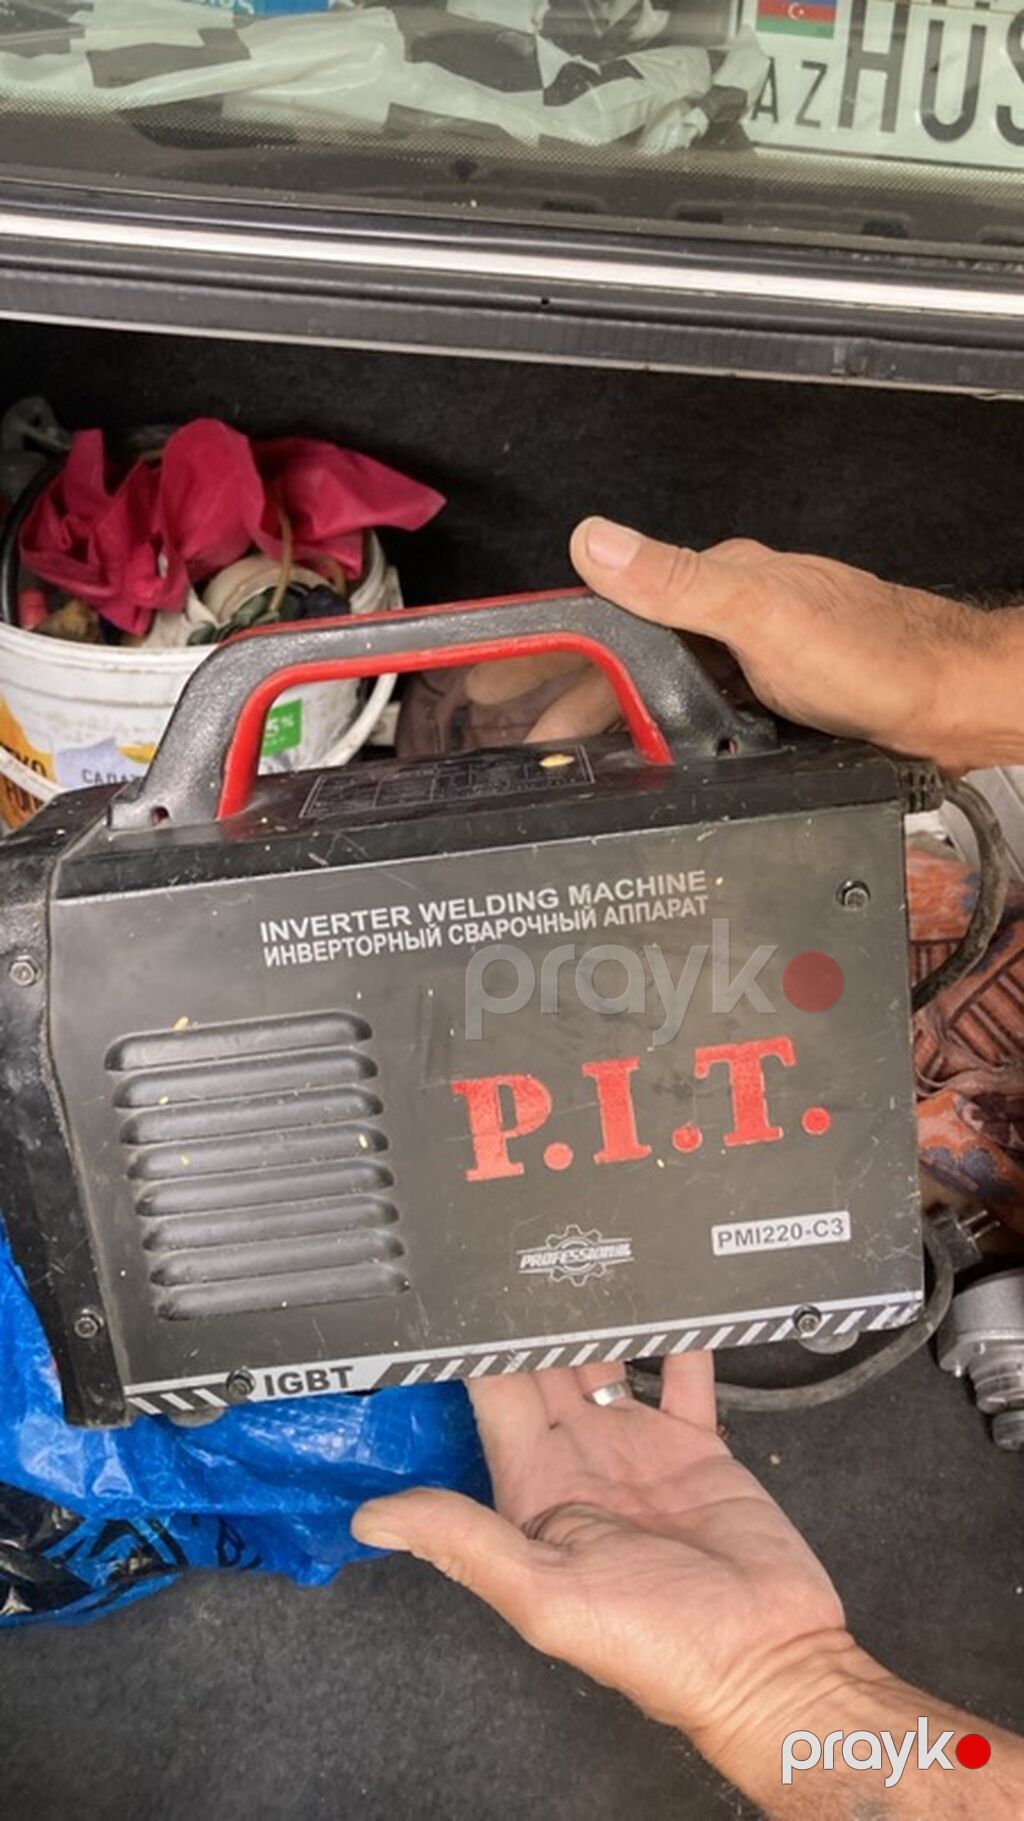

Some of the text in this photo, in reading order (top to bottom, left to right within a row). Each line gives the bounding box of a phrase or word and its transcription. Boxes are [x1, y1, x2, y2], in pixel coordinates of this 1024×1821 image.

[751, 56, 828, 129] AZ
[260, 870, 708, 943] INVERTER WELDING MACHINE
[264, 895, 709, 968] ИНВЕРТОРНЫЙ СВАРОЧНЫЙ АППАРАТ
[451, 1035, 832, 1182] P.I.T.
[717, 1217, 844, 1249] PMI220-C3
[263, 1365, 354, 1397] IGBT
